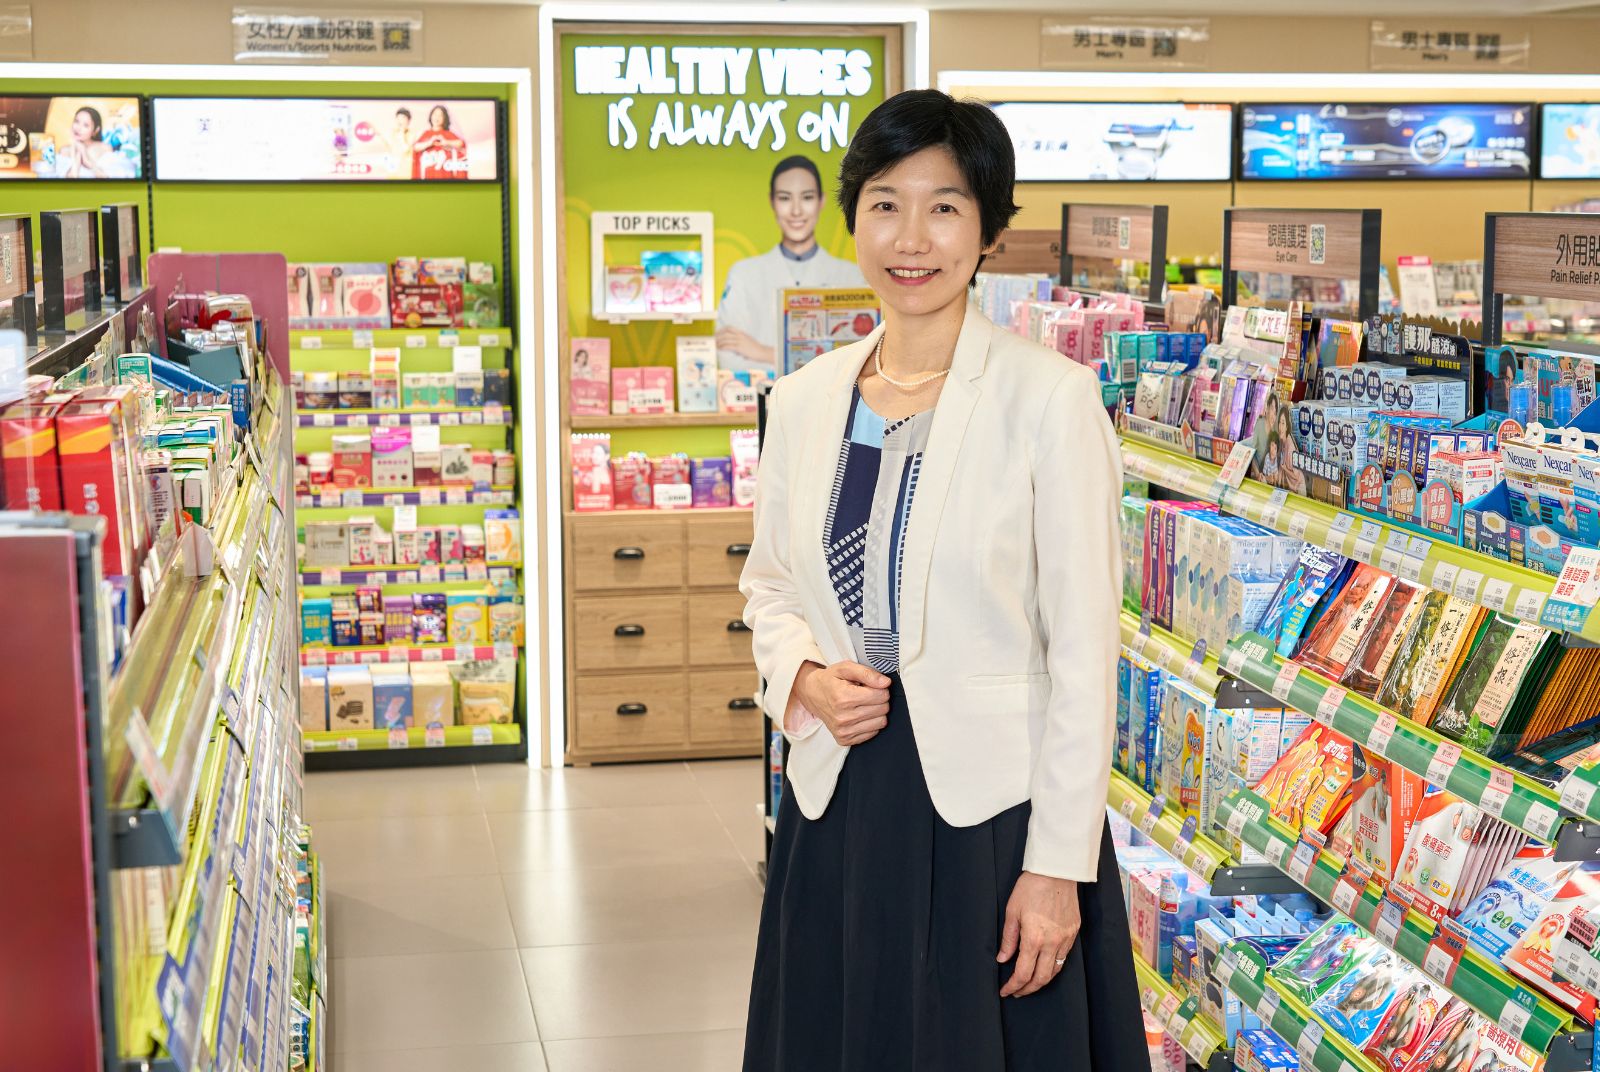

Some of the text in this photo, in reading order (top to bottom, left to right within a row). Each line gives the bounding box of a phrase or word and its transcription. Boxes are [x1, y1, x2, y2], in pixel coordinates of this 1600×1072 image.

[574, 46, 873, 97] HEALTHY VIBES
[607, 97, 638, 149] IS
[649, 100, 788, 150] ALWAYS
[612, 216, 691, 231] TOP PICKS
[1267, 223, 1308, 250] 眼睛護理
[1276, 251, 1298, 264] Eye Care
[1550, 270, 1568, 283] Pain
[1569, 270, 1593, 285] Relief
[1507, 451, 1537, 470] Nexcare
[1578, 464, 1595, 484] Nex
